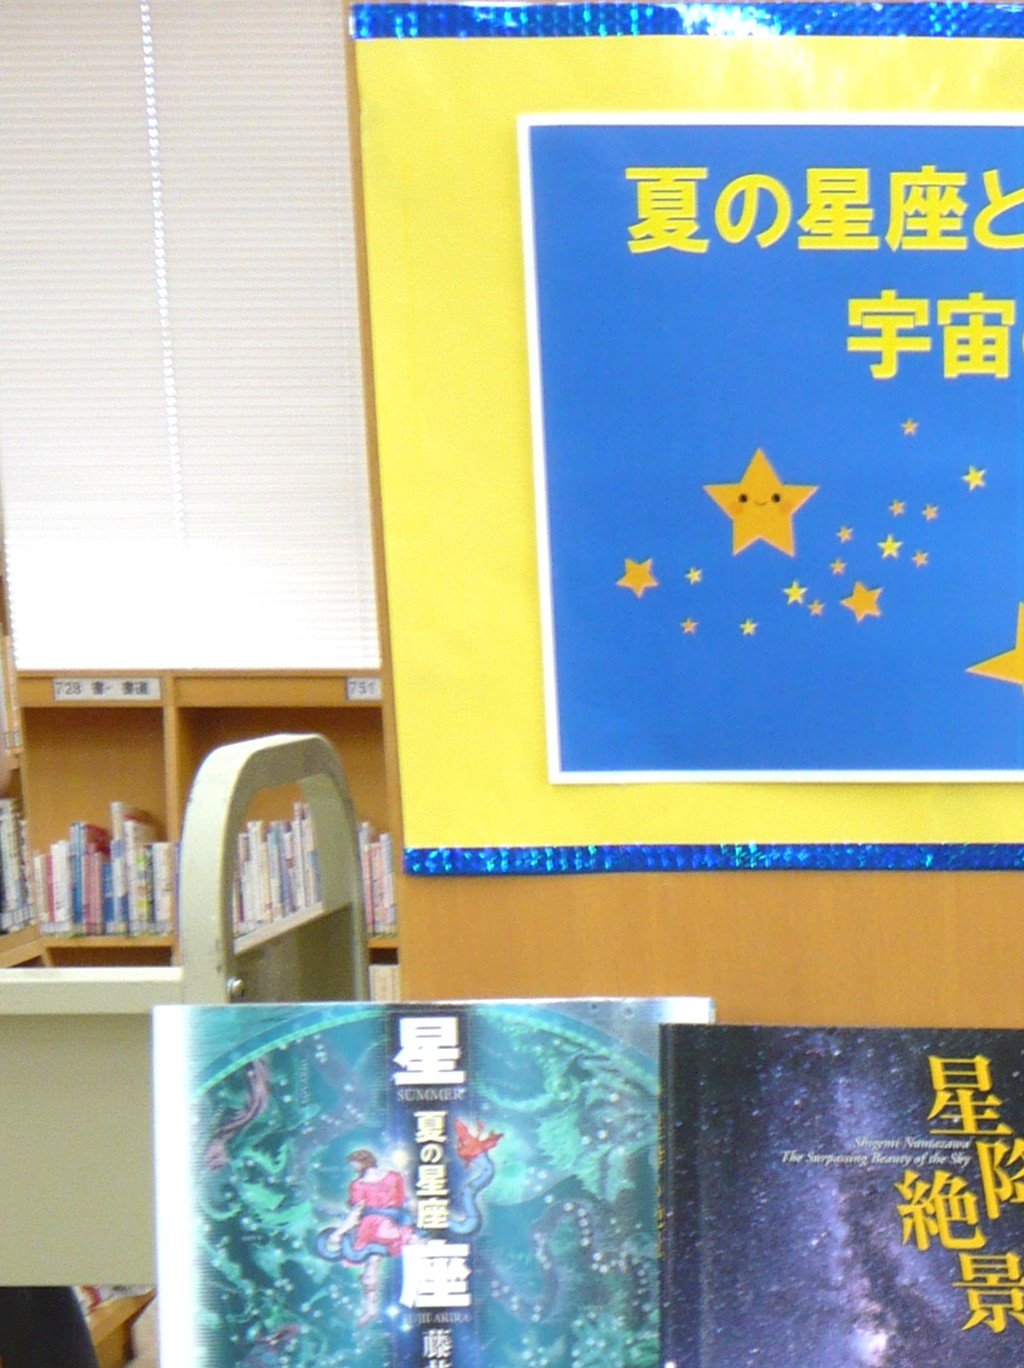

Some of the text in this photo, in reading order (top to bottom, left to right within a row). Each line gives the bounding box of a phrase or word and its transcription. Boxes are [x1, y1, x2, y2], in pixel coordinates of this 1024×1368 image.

[393, 1016, 466, 1085] 星
[414, 1111, 449, 1229] 夏の星座
[400, 1239, 472, 1308] 座
